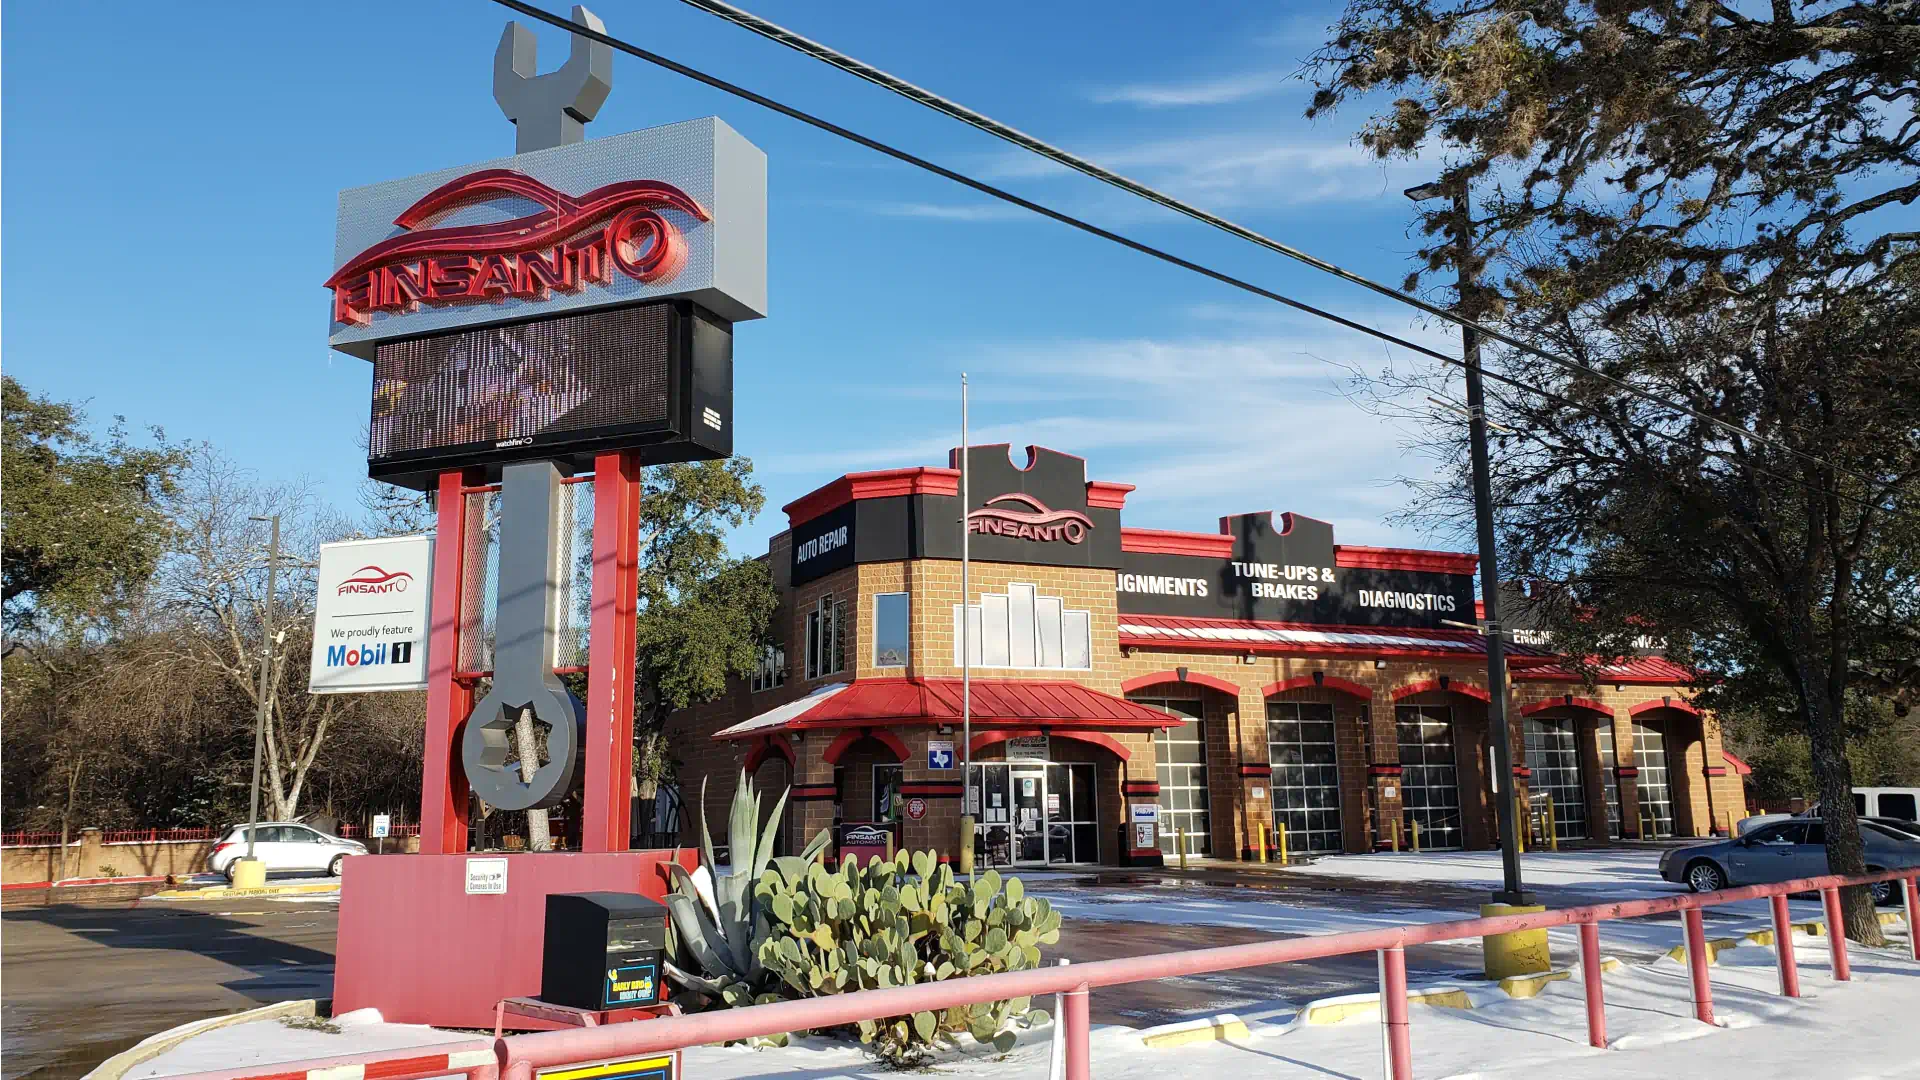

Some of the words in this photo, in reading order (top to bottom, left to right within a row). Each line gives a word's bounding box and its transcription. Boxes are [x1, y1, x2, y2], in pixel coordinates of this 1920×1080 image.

[334, 206, 688, 325] FINSANTO
[966, 519, 1085, 543] FINSANTO
[797, 538, 818, 564] AUTO
[819, 525, 848, 555] REPAIR
[1231, 562, 1318, 582] TUNE-UPS
[1321, 567, 1336, 583] &
[338, 578, 407, 596] FINSANTO
[1115, 573, 1209, 597] IGNMENTS
[1251, 583, 1318, 601] BRAKES
[1358, 589, 1456, 612] DIAGNOSTICS
[331, 629, 345, 638] We
[347, 626, 380, 640] proudly
[382, 624, 413, 635] feature
[327, 643, 387, 667] Mobil
[470, 873, 488, 882] Security
